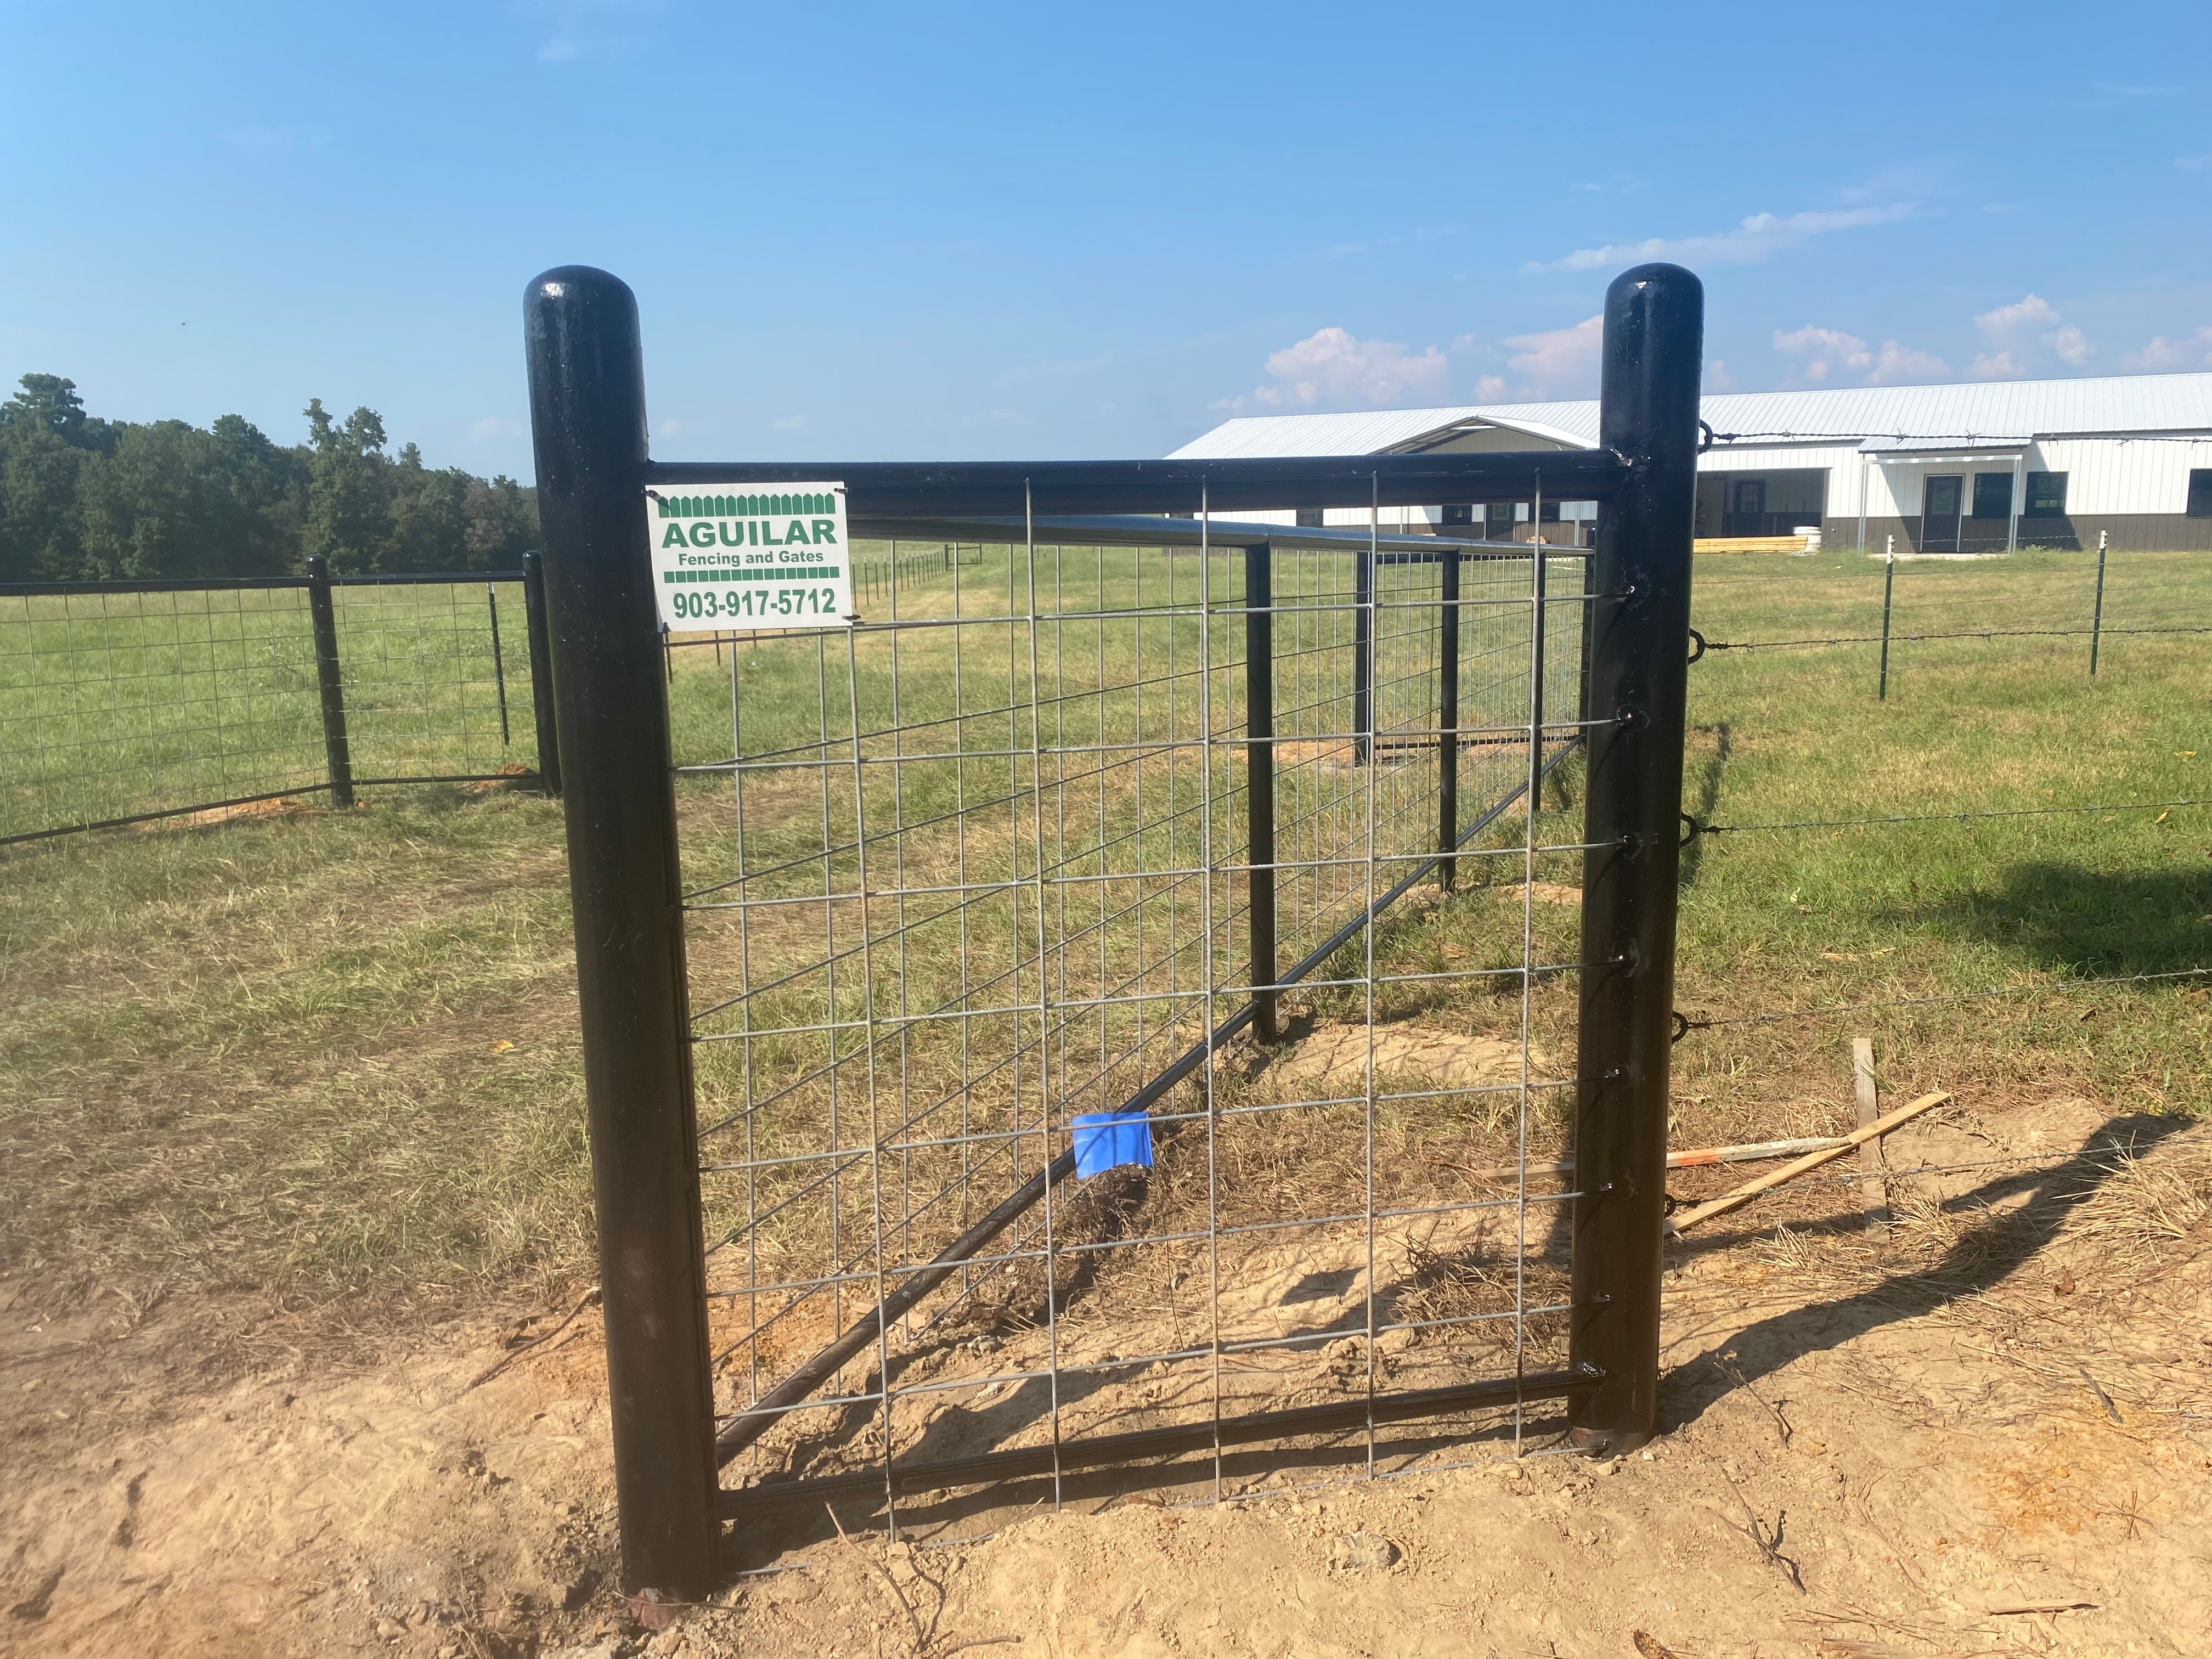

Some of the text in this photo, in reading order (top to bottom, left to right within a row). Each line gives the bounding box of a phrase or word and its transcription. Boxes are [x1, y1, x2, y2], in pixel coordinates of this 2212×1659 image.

[662, 520, 837, 548] AGUILAR
[678, 550, 823, 567] Fencing and Gates
[673, 588, 836, 618] 903-917-5712
